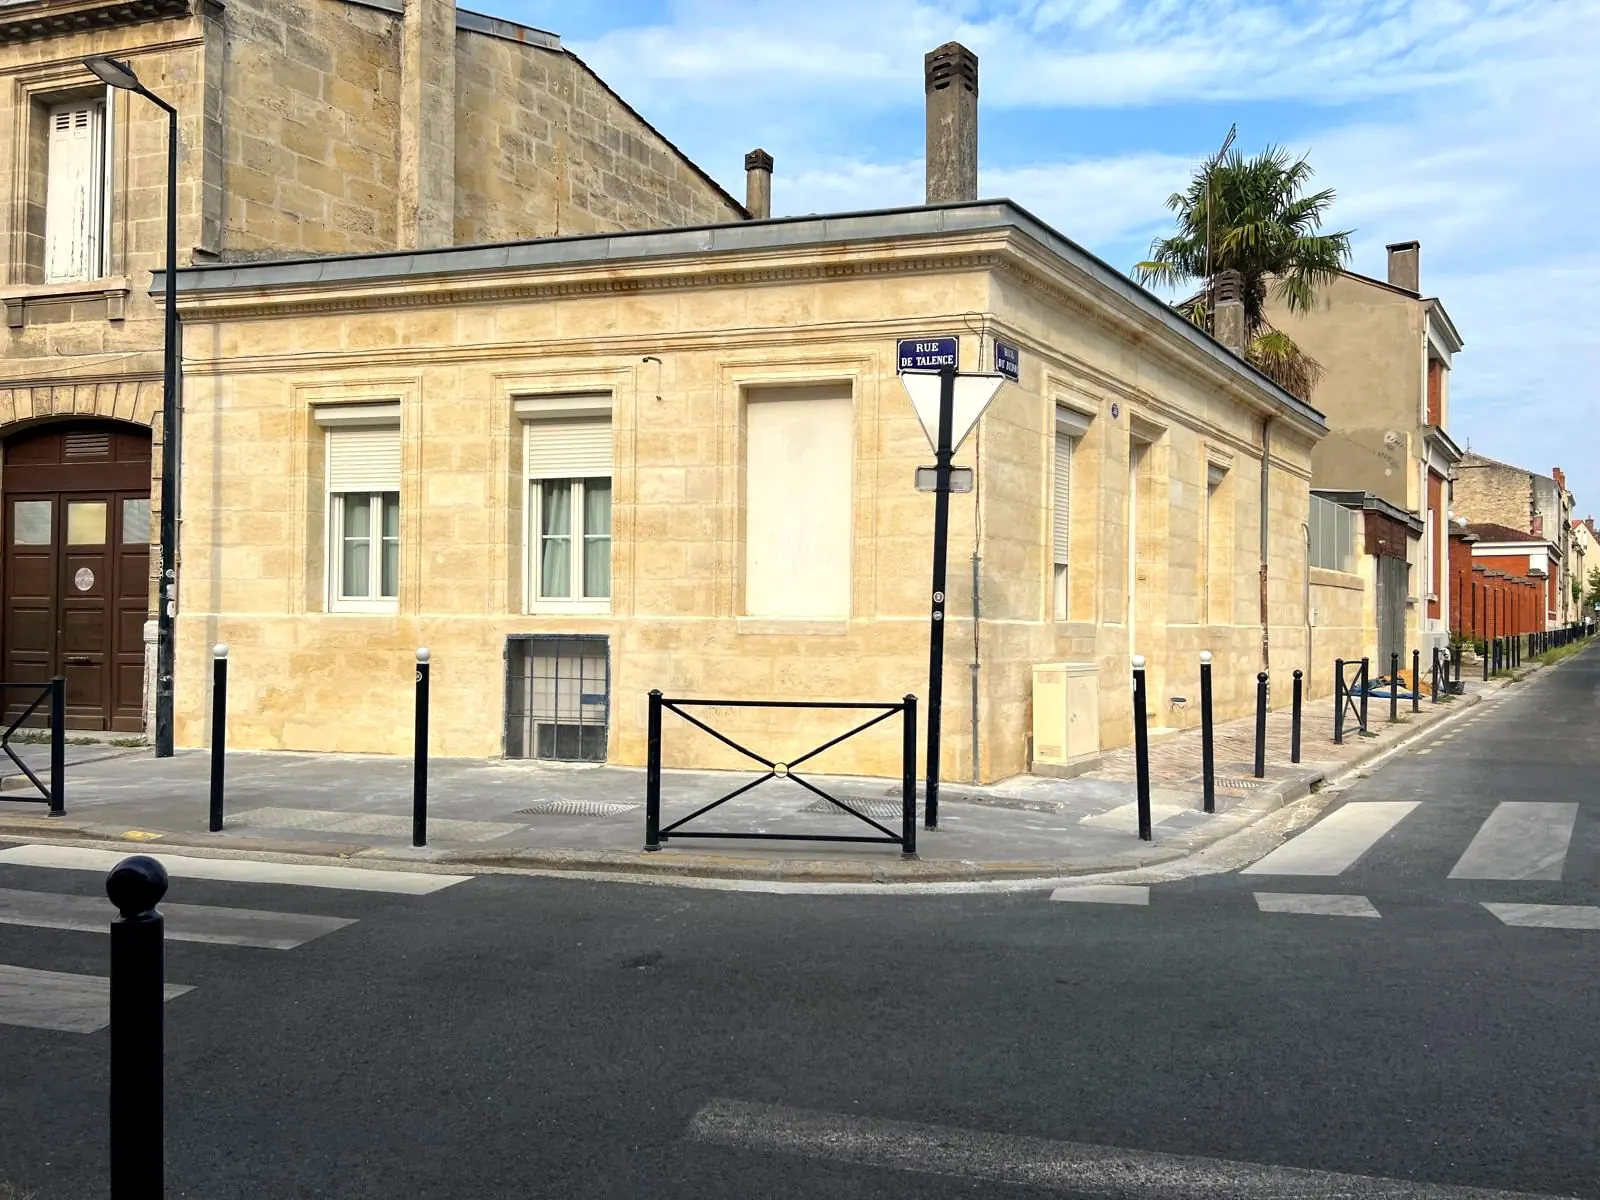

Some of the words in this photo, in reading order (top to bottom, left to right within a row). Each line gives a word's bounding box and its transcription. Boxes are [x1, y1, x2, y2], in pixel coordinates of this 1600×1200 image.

[916, 343, 939, 352] RUE
[901, 357, 913, 367] DE
[916, 355, 954, 366] TALENCE
